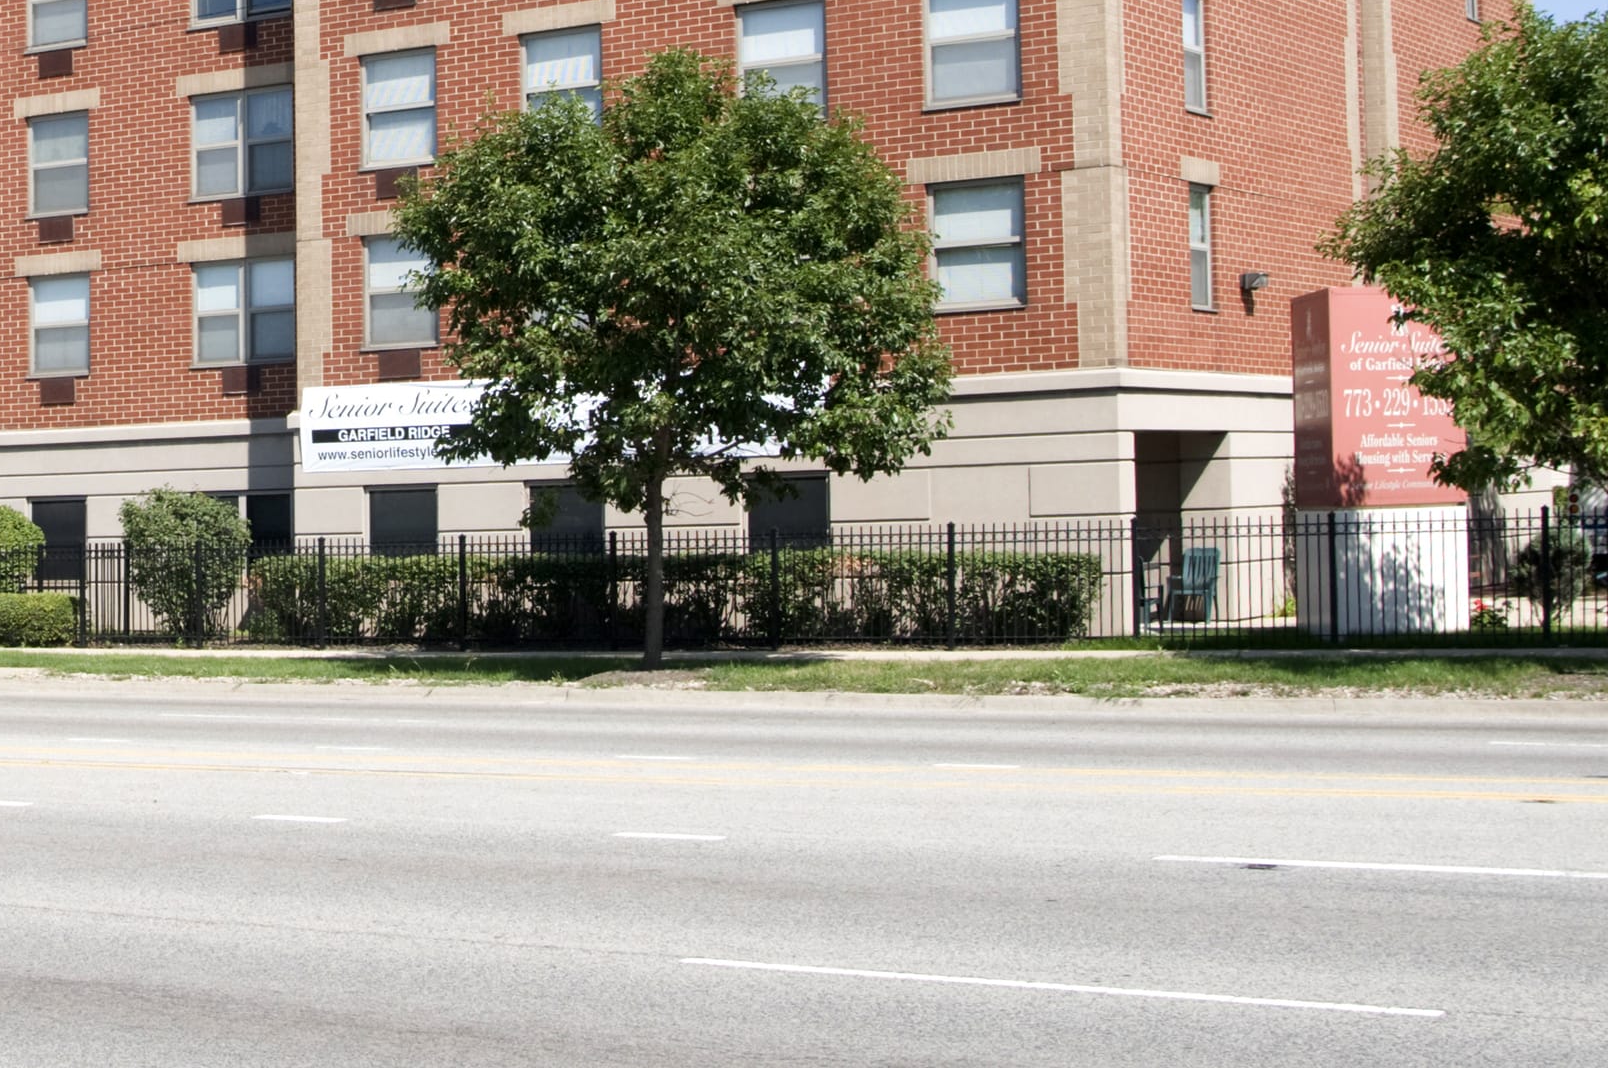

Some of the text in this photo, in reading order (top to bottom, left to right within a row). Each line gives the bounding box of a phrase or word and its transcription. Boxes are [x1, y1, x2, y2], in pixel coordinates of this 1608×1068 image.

[1340, 331, 1400, 353] Senior
[1349, 358, 1362, 371] of
[1365, 357, 1413, 371] Garfield
[309, 389, 474, 419] Senior Suites
[338, 426, 450, 442] GARFIELD RIDGE
[1360, 433, 1438, 448] Affordable Seniors
[318, 445, 437, 461] www.seniorlifestyle
[1355, 451, 1391, 467] Housing
[1392, 451, 1410, 465] with
